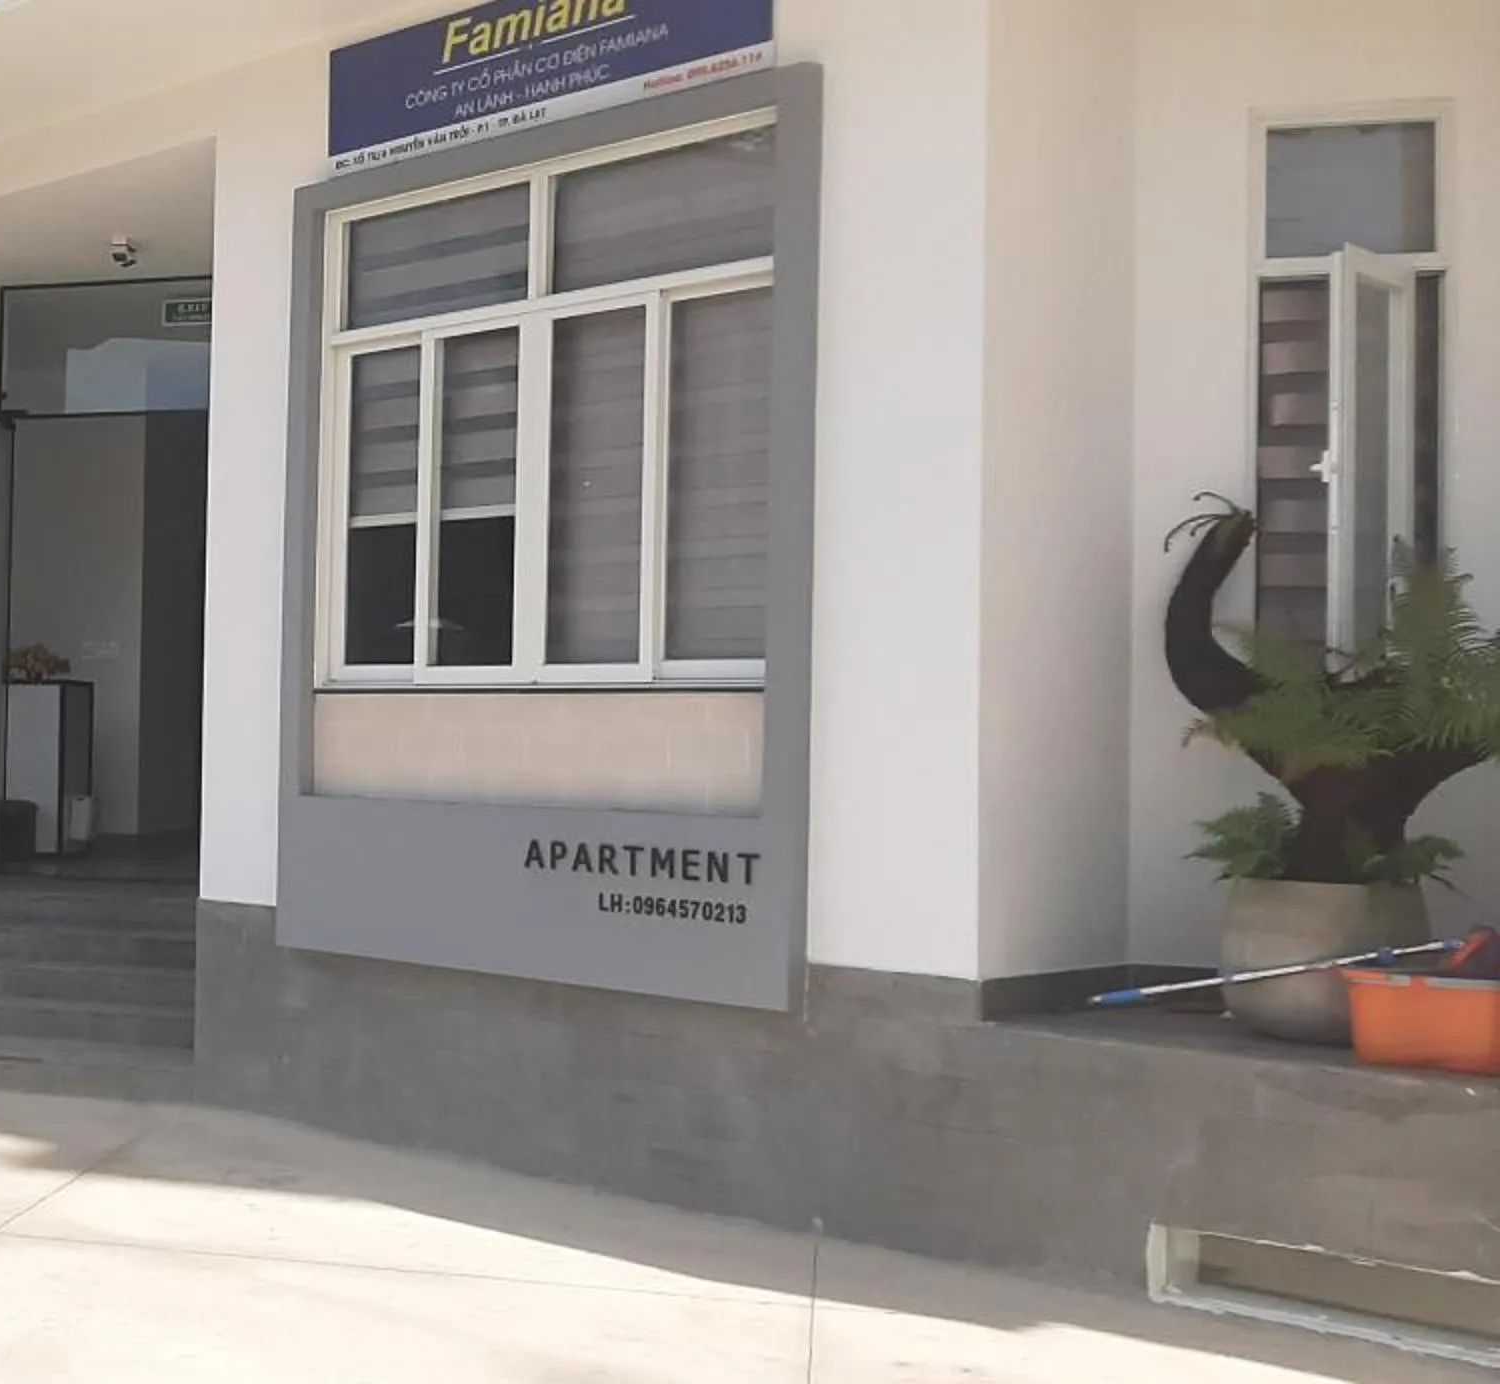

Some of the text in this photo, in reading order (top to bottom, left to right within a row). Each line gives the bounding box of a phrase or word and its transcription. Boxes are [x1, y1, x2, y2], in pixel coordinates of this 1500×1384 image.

[442, 0, 625, 64] Famiana
[451, 79, 466, 97] TY
[599, 23, 669, 56] FAMIANA
[524, 839, 761, 885] APARTMENT
[598, 892, 747, 925] LH:0964570213
